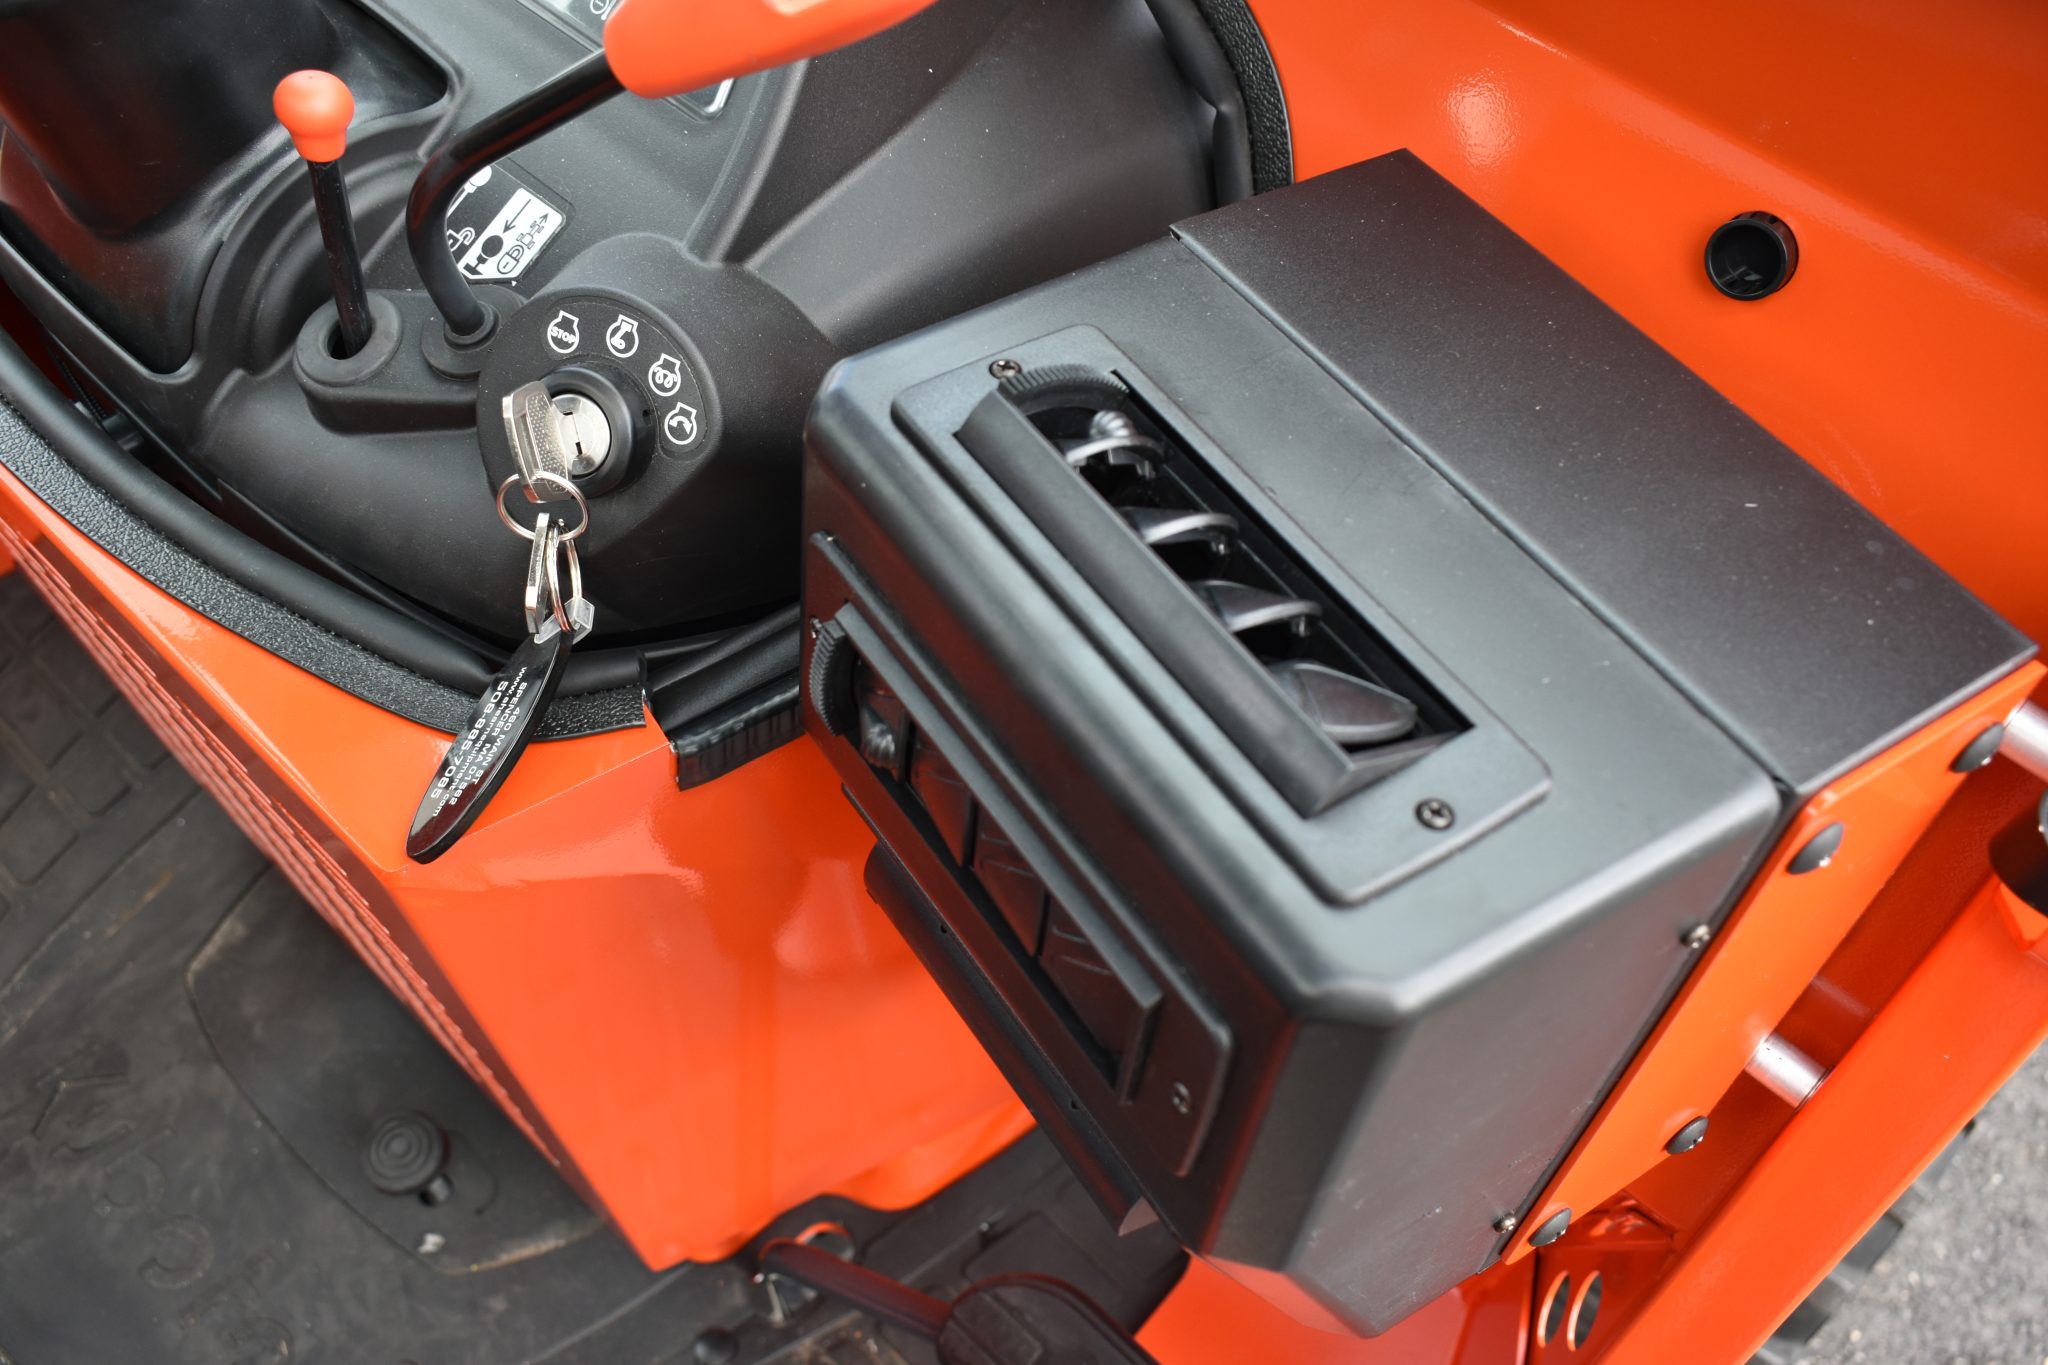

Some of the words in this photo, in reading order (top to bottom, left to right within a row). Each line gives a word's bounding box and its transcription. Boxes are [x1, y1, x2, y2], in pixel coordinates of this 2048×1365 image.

[551, 325, 577, 344] STOP
[491, 682, 528, 736] SPENCER
[504, 707, 520, 731] 460
[430, 681, 509, 798] 508-885-7085
[432, 666, 527, 817] www.ahearnequipment.com
[475, 743, 491, 762] MA
[482, 735, 506, 766] MAIN
[449, 766, 477, 806] 01562
[472, 769, 484, 785] ST
